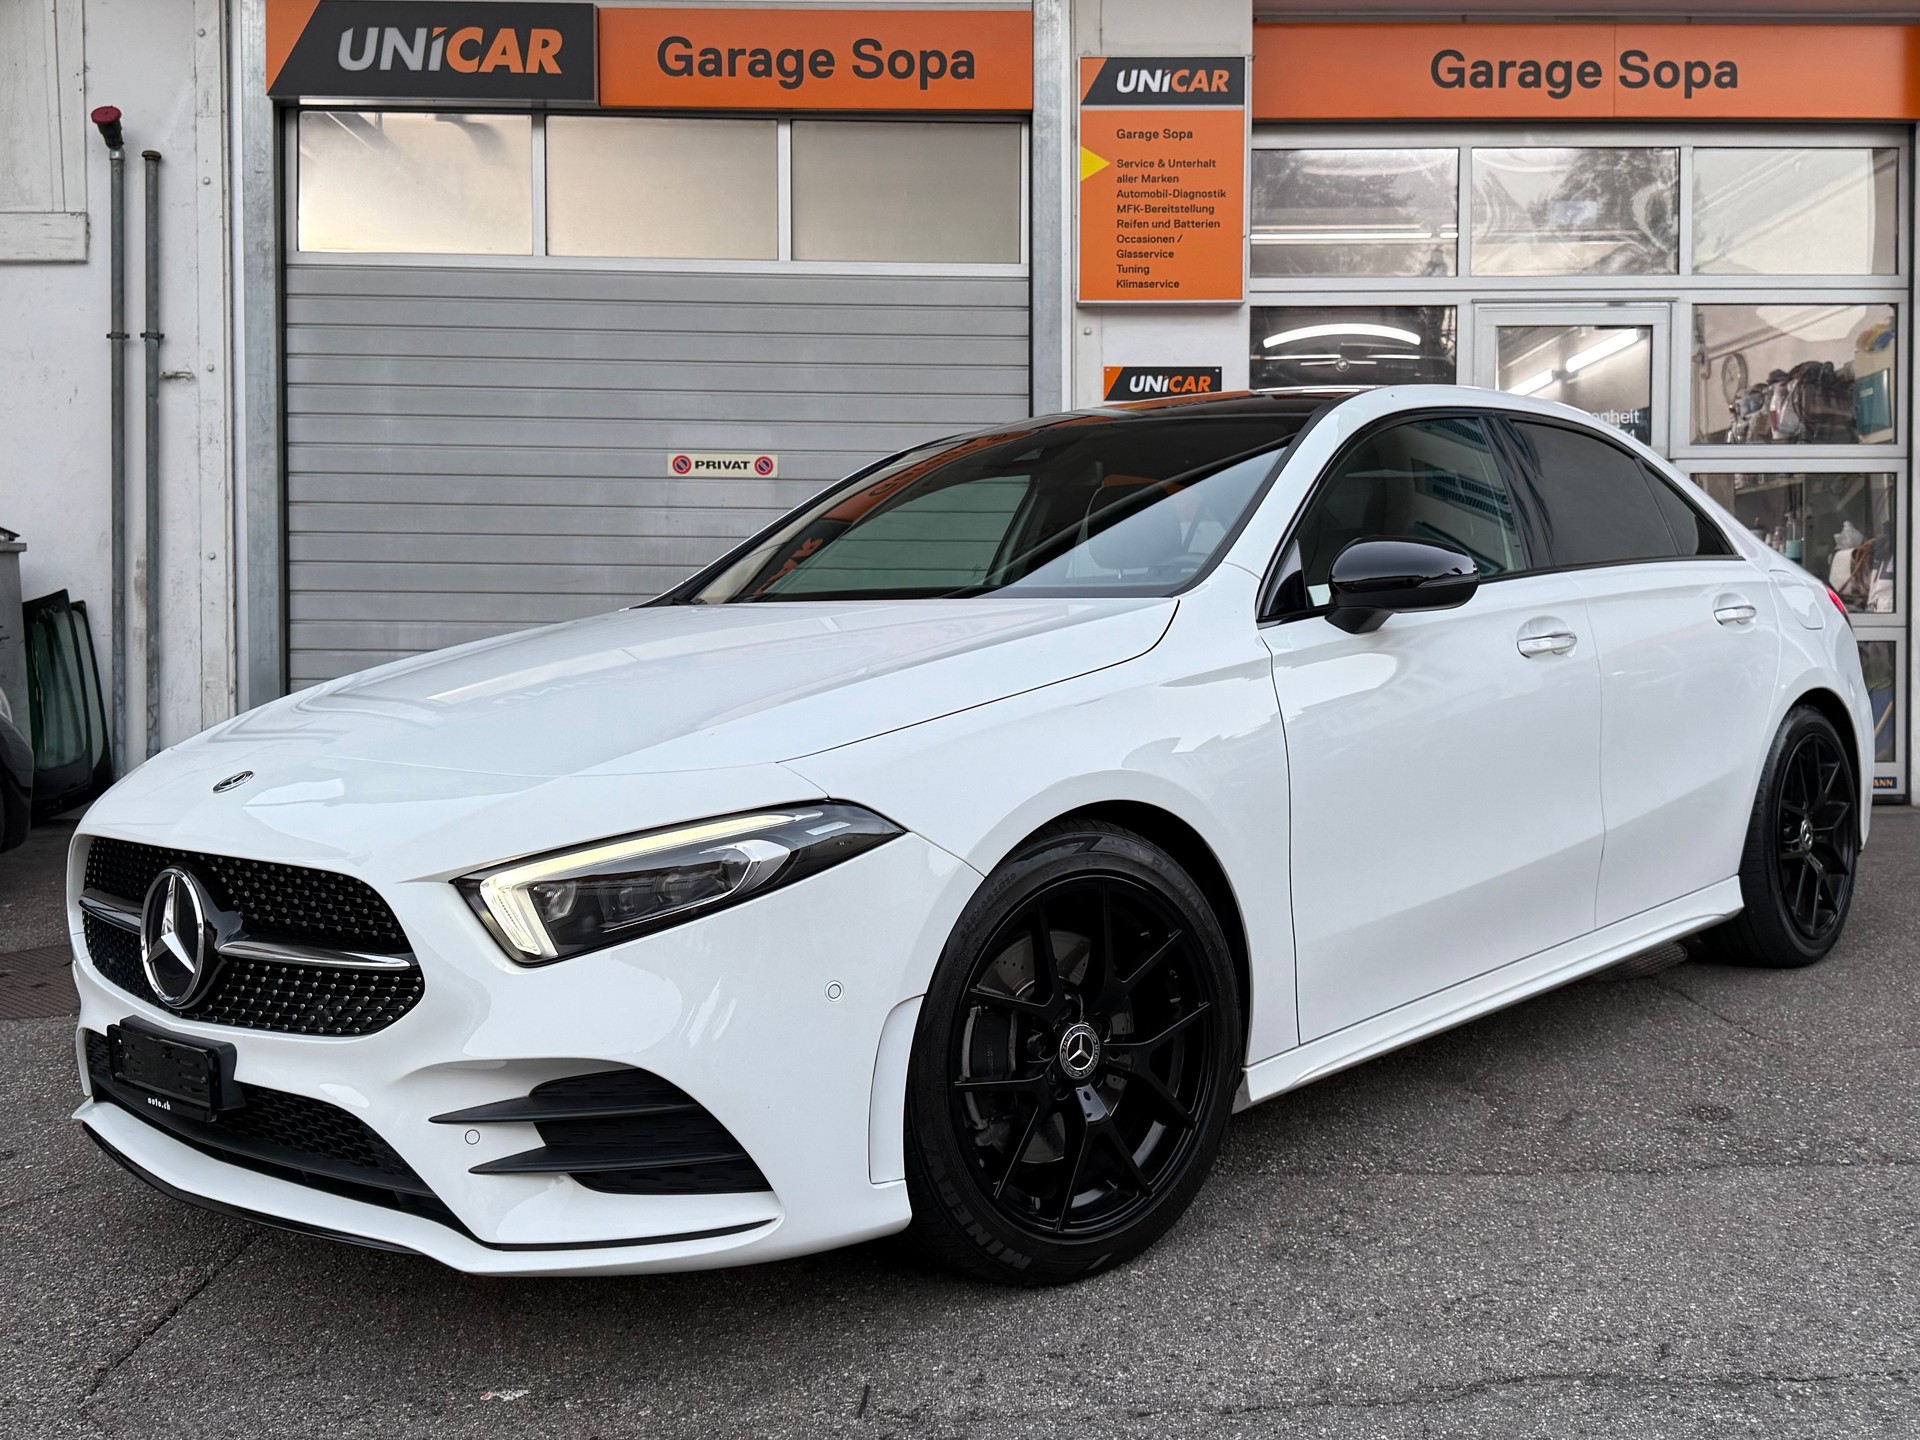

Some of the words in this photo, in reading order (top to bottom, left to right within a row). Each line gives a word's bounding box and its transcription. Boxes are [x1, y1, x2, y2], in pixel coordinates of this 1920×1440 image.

[657, 36, 836, 90] Garage
[852, 37, 975, 91] Sopa
[1431, 49, 1603, 100] Garage
[1618, 49, 1738, 100] Sopa
[1116, 128, 1160, 142] Garage
[1162, 128, 1194, 142] Sopa
[1116, 158, 1155, 169] Service
[1157, 158, 1166, 169] &
[1168, 158, 1216, 169] Unterhalt
[1116, 173, 1139, 184] aller
[1141, 173, 1180, 184] Marken
[1116, 189, 1227, 201] Automobil-Diagnostik
[1116, 204, 1215, 216] MFK-Bereitstellung
[1116, 219, 1150, 229] Reifen
[1151, 219, 1171, 229] und
[1173, 219, 1221, 229] Batterien
[1116, 234, 1175, 244] Occasionen
[1116, 249, 1175, 259] Glasservice
[1116, 264, 1150, 276] Tuning
[1116, 279, 1180, 289] Klimaservice
[694, 459, 751, 471] PRIVAT
